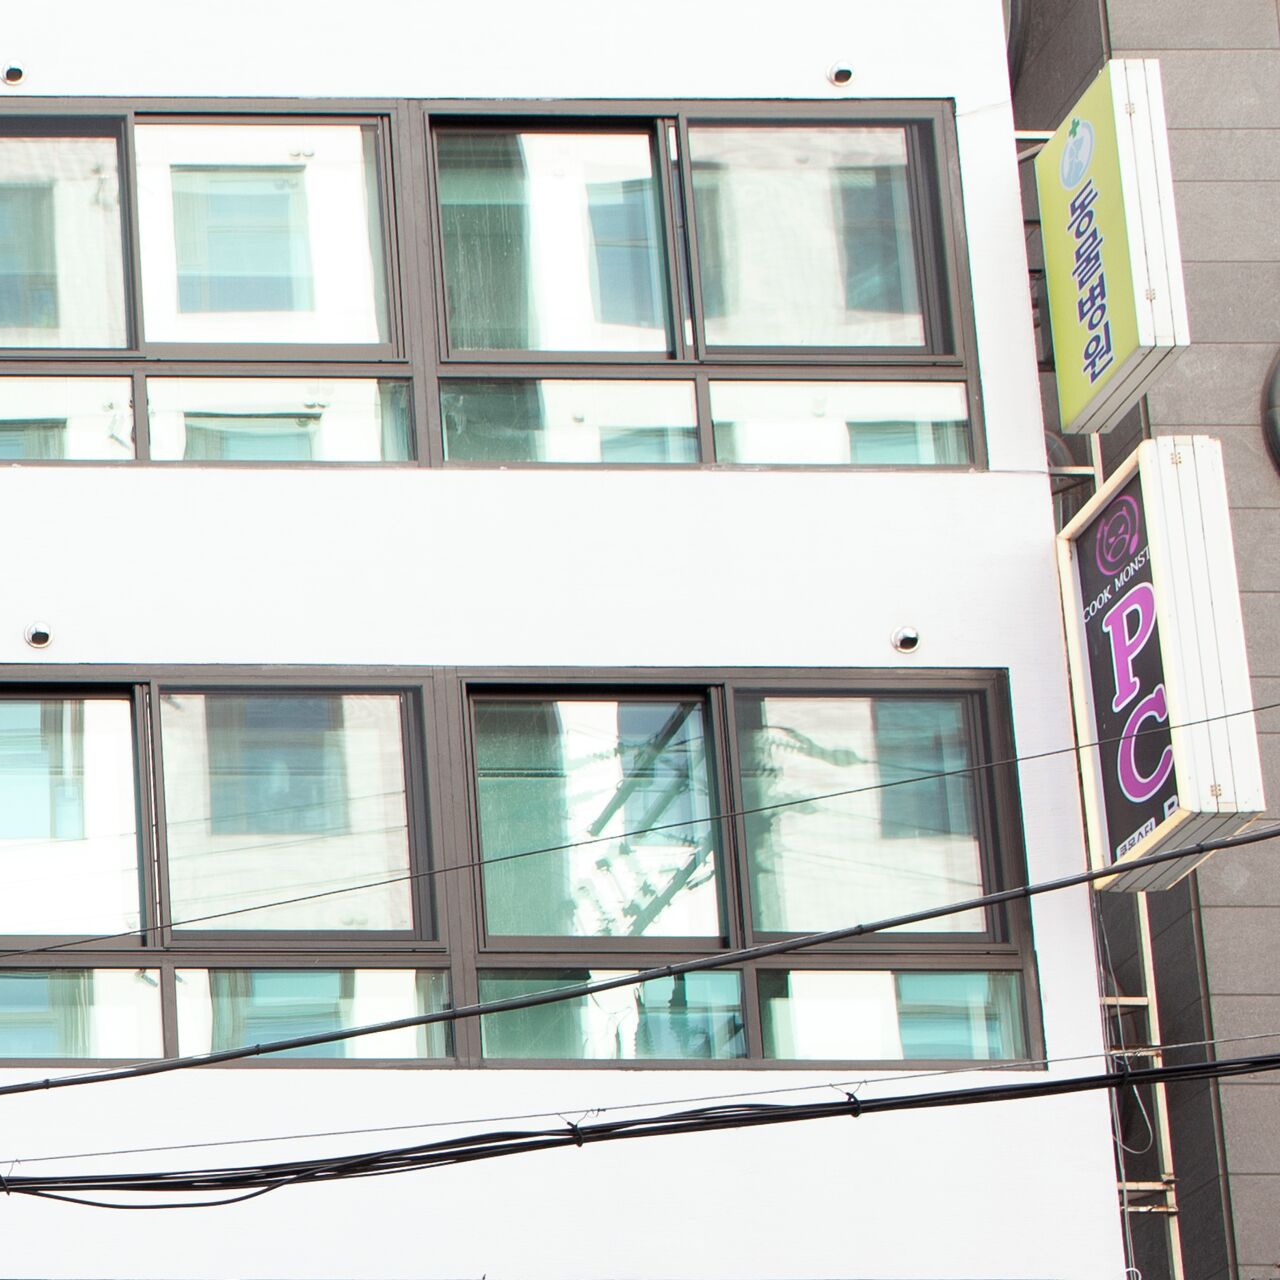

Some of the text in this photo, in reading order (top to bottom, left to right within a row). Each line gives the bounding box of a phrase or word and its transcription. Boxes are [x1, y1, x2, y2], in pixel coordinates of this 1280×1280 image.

[1067, 179, 1113, 384] 동물병원
[1082, 545, 1151, 625] COOK MONST
[1102, 581, 1175, 804] PC
